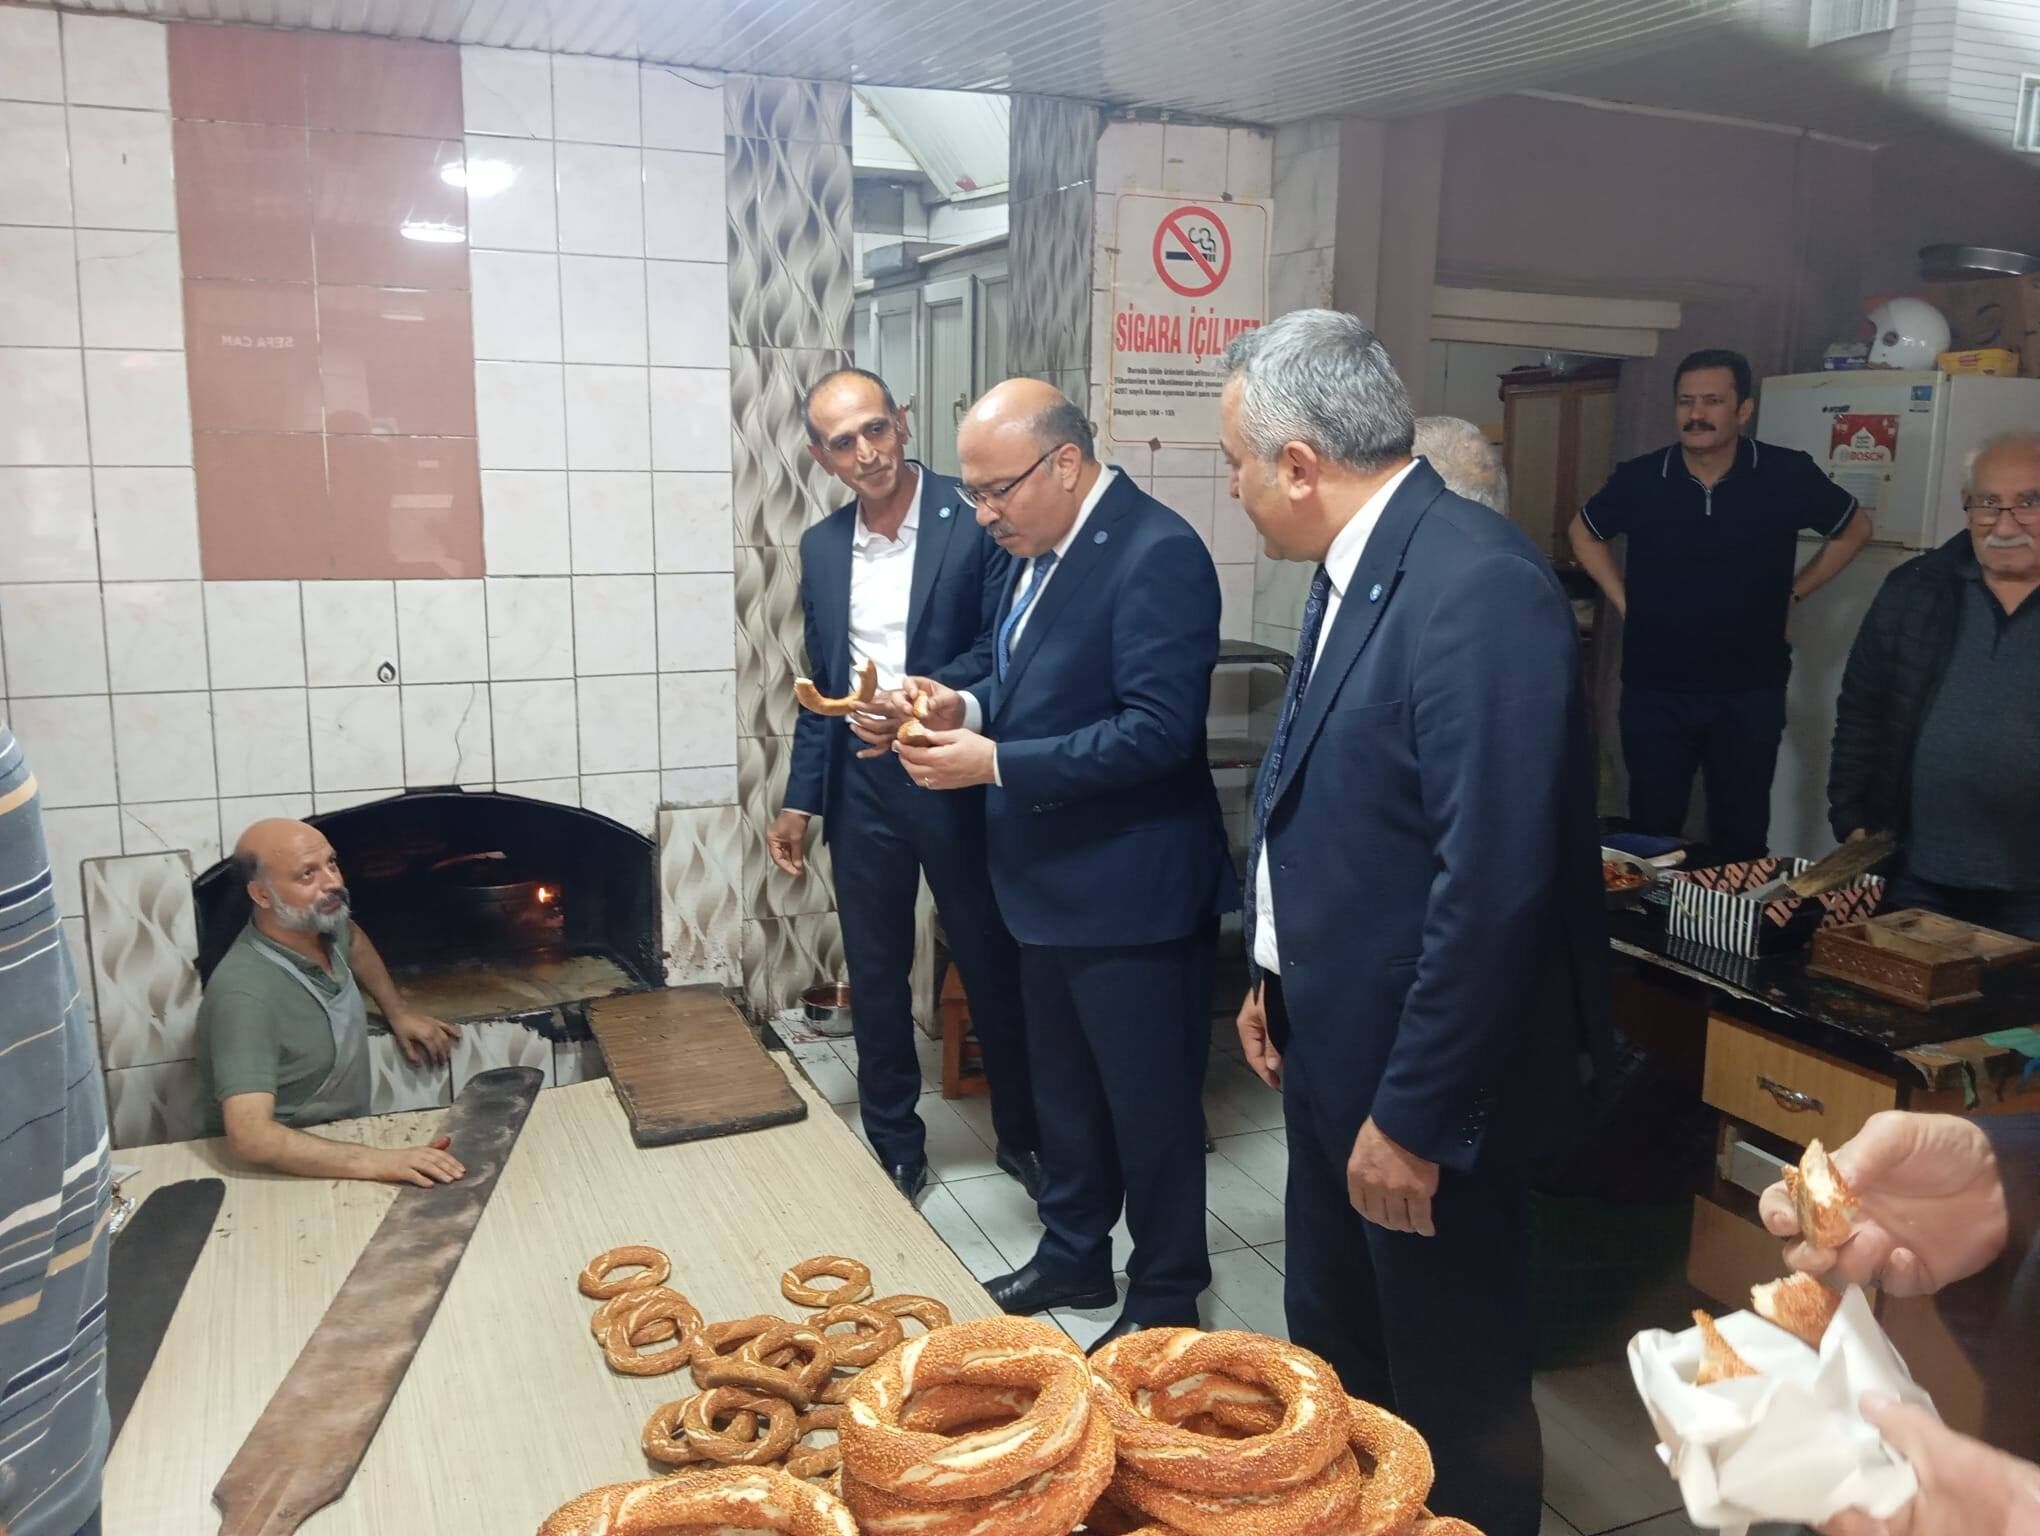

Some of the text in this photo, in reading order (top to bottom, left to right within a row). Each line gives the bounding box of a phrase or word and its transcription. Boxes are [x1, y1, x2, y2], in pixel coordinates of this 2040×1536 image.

[1115, 303, 1261, 364] SİGARA İÇİLM
[1849, 451, 1884, 462] BOSCH
